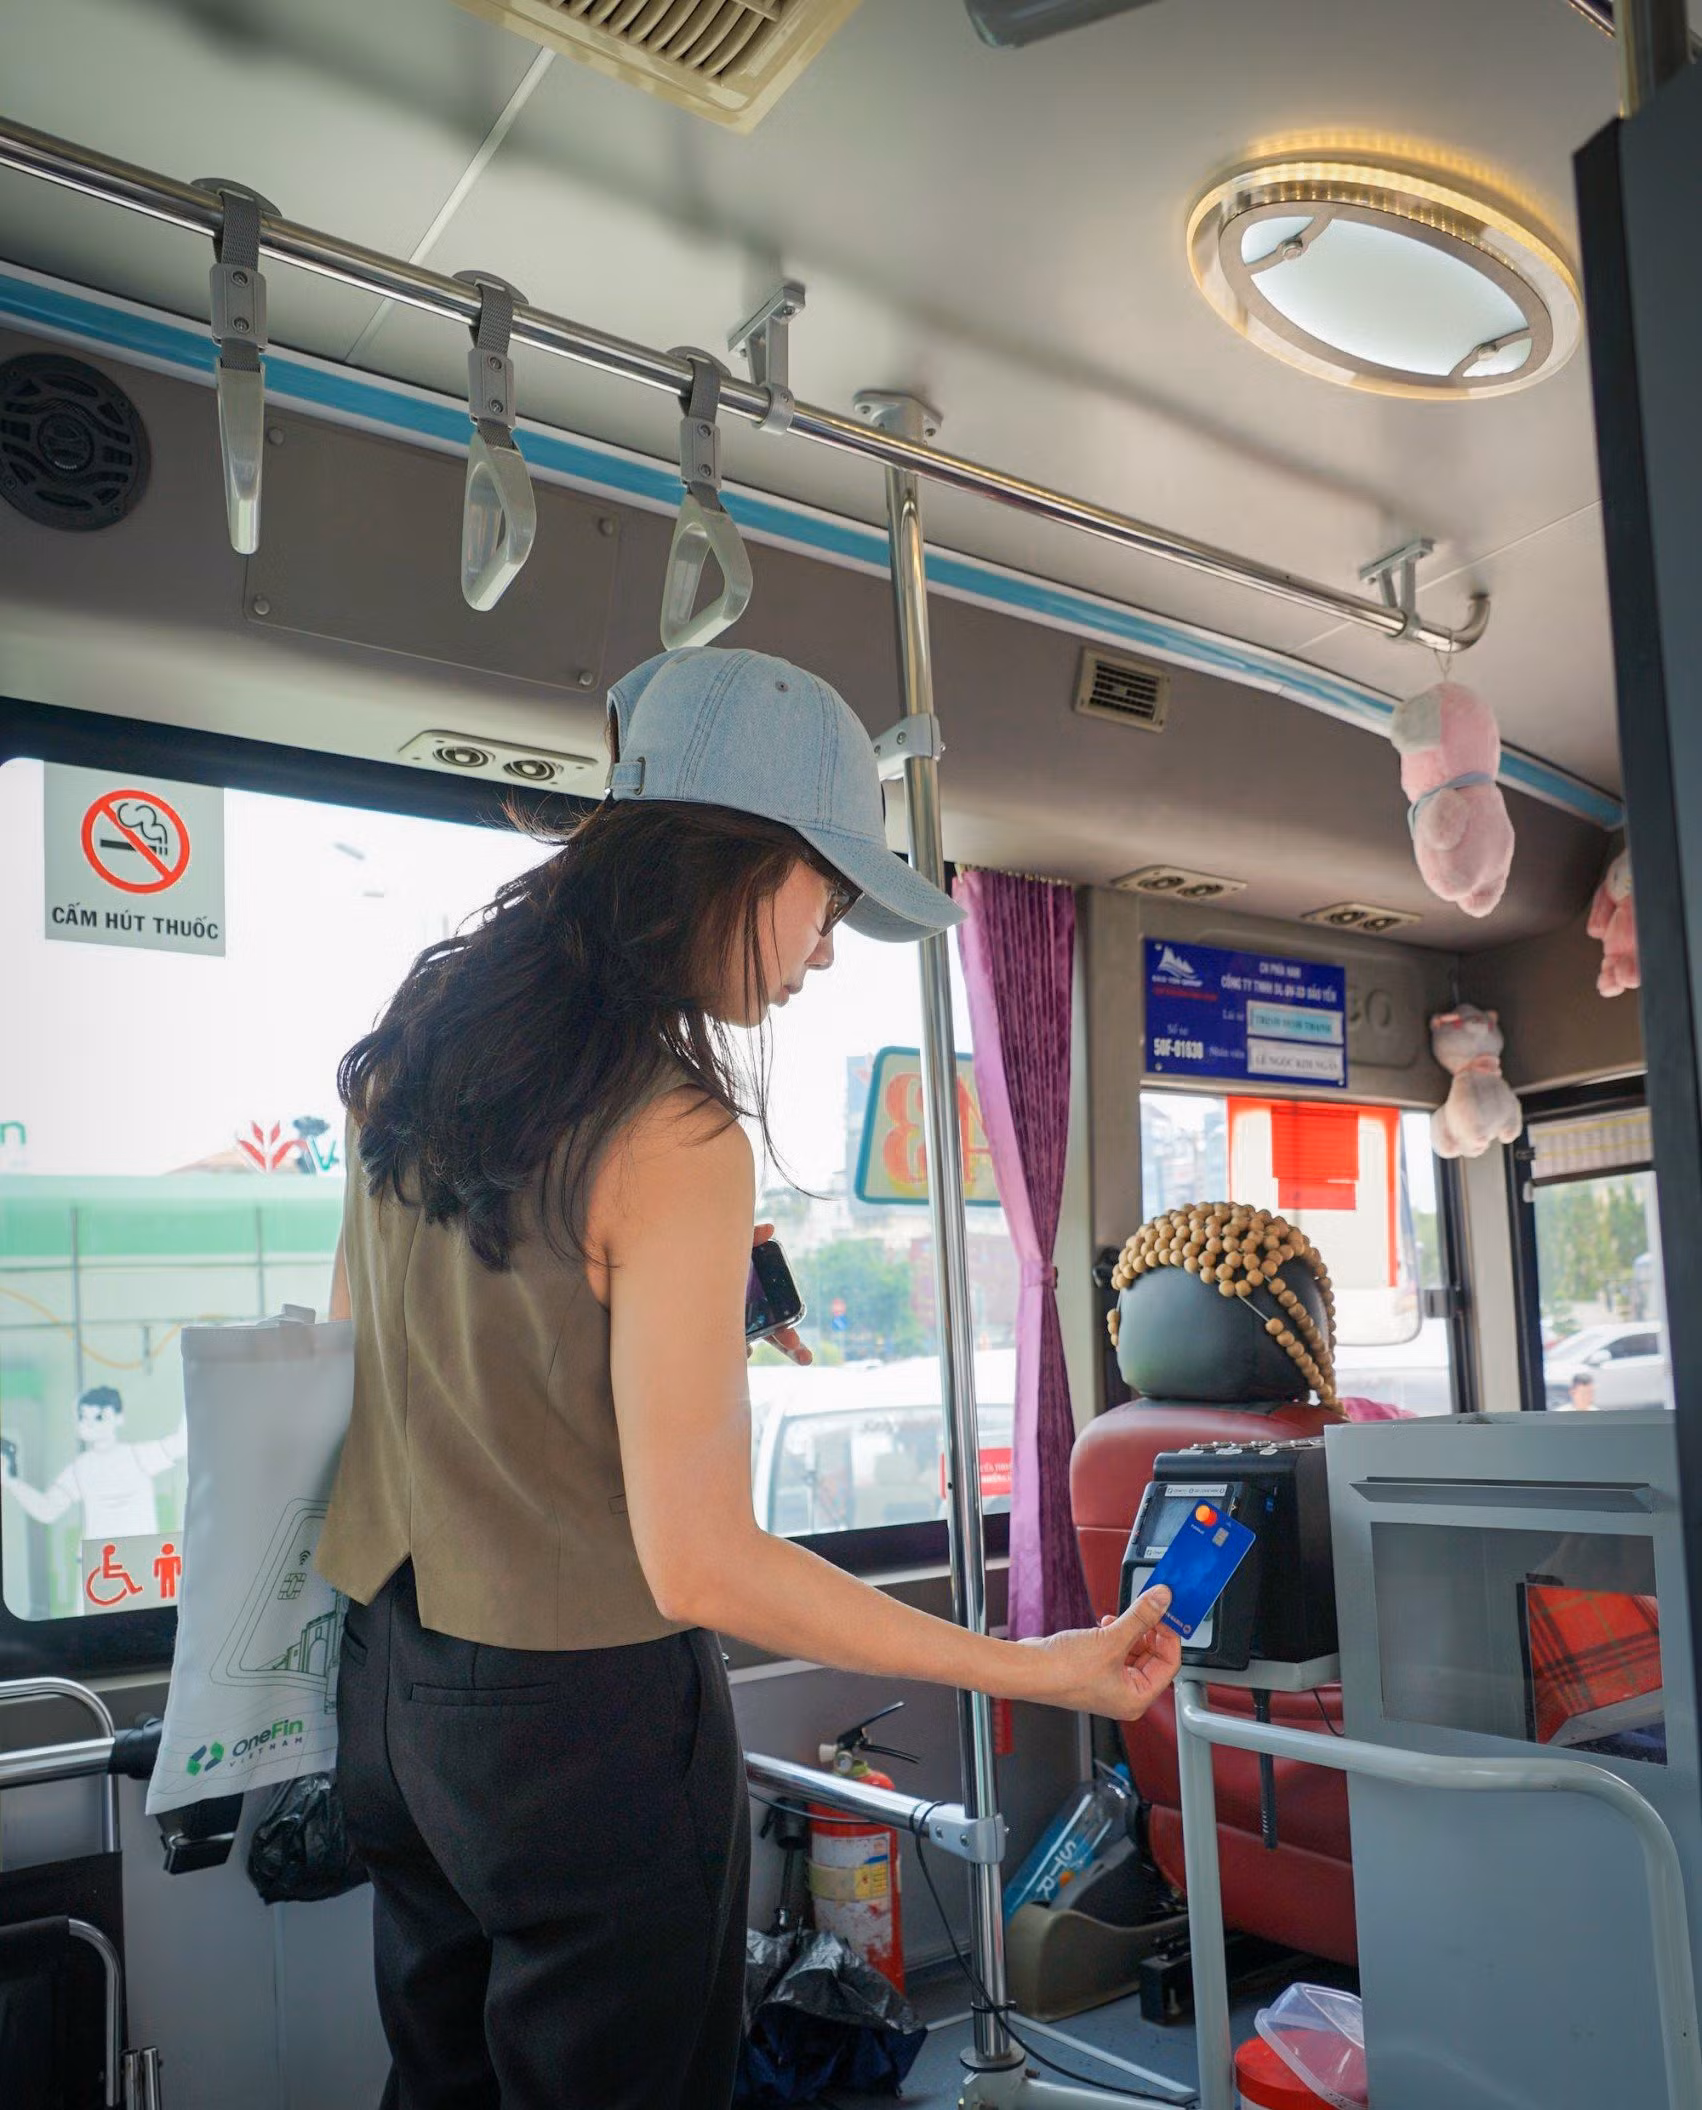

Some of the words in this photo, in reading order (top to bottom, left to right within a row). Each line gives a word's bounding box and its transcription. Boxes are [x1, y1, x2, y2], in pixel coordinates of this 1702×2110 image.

[52, 902, 98, 928] CẤM
[105, 909, 145, 931] HÚT
[153, 916, 218, 940] THUỐC
[1242, 977, 1252, 992] TY
[229, 1736, 303, 1768] VIETNAM
[232, 1719, 303, 1757] OneFin
